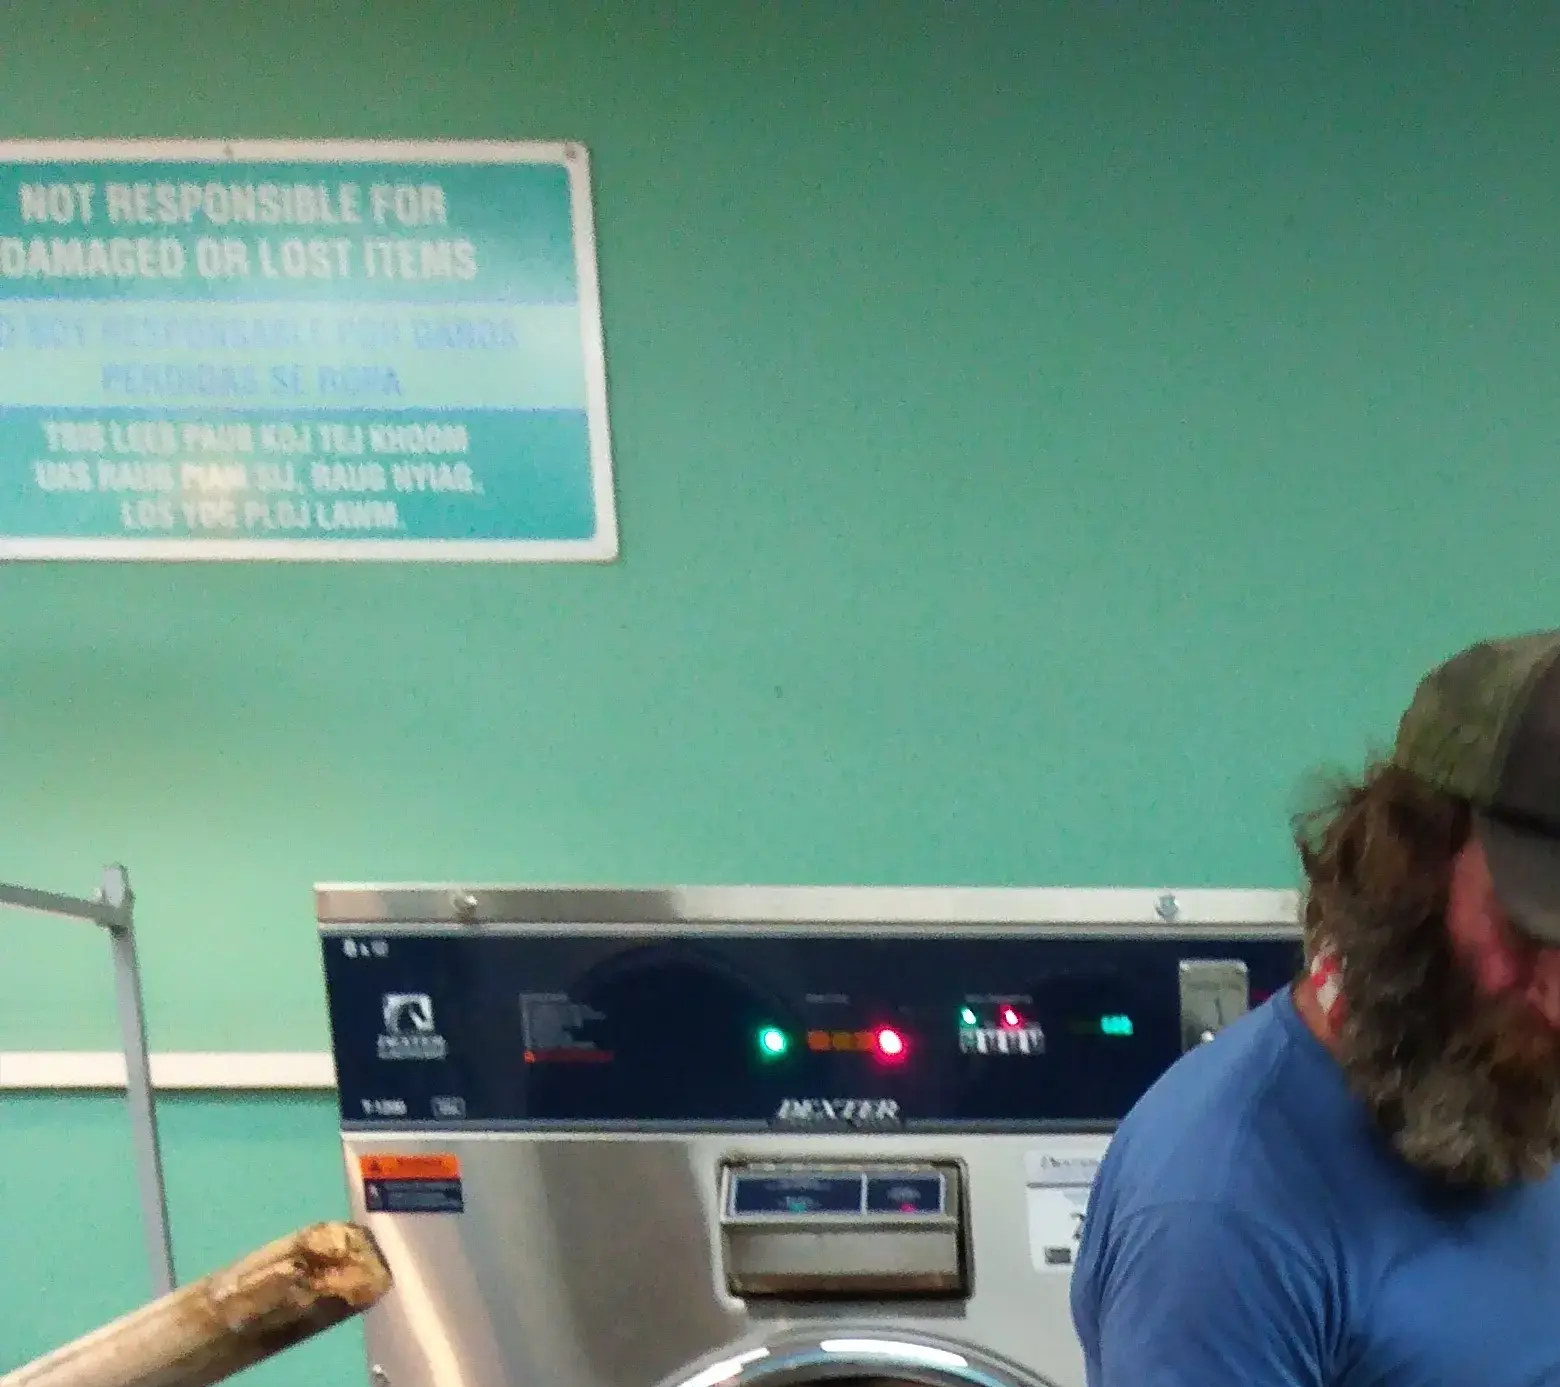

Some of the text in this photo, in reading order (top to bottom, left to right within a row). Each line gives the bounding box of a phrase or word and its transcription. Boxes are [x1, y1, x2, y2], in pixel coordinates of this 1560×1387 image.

[20, 182, 447, 225] NOT RESPONSIBLE FOR
[0, 236, 477, 280] DAMAGED OR LOST ITEMS
